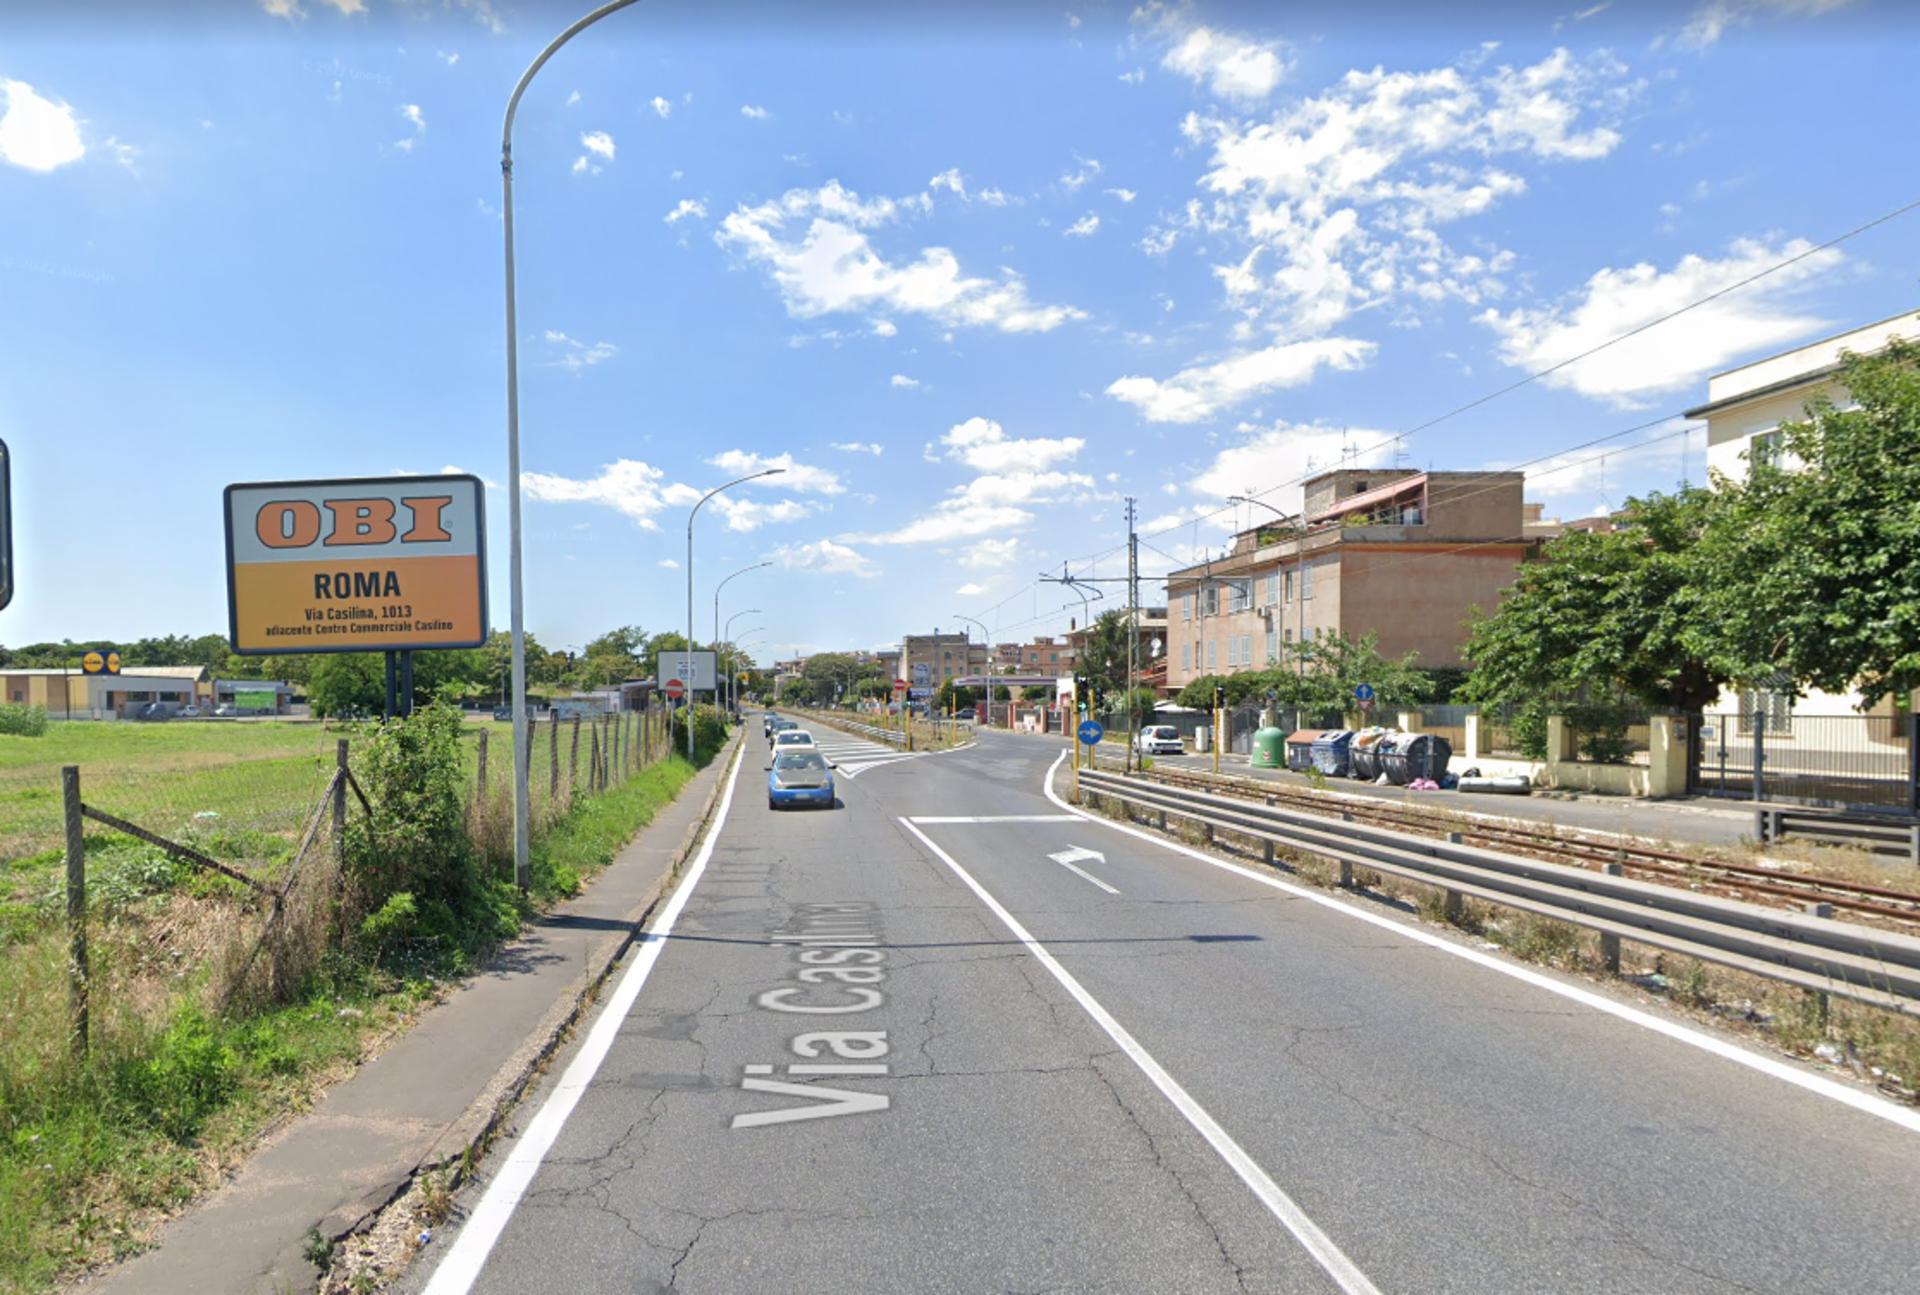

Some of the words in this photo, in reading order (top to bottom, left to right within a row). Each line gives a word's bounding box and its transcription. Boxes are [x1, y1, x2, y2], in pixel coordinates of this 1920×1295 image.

[255, 496, 452, 549] OBI
[314, 571, 401, 599] ROMA
[305, 607, 323, 621] Via
[327, 606, 378, 621] Casilina,
[382, 605, 412, 619] 1013
[266, 624, 312, 636] adiacente
[315, 623, 347, 634] Centro
[350, 621, 412, 634] Commerciale
[415, 619, 453, 631] Casilino
